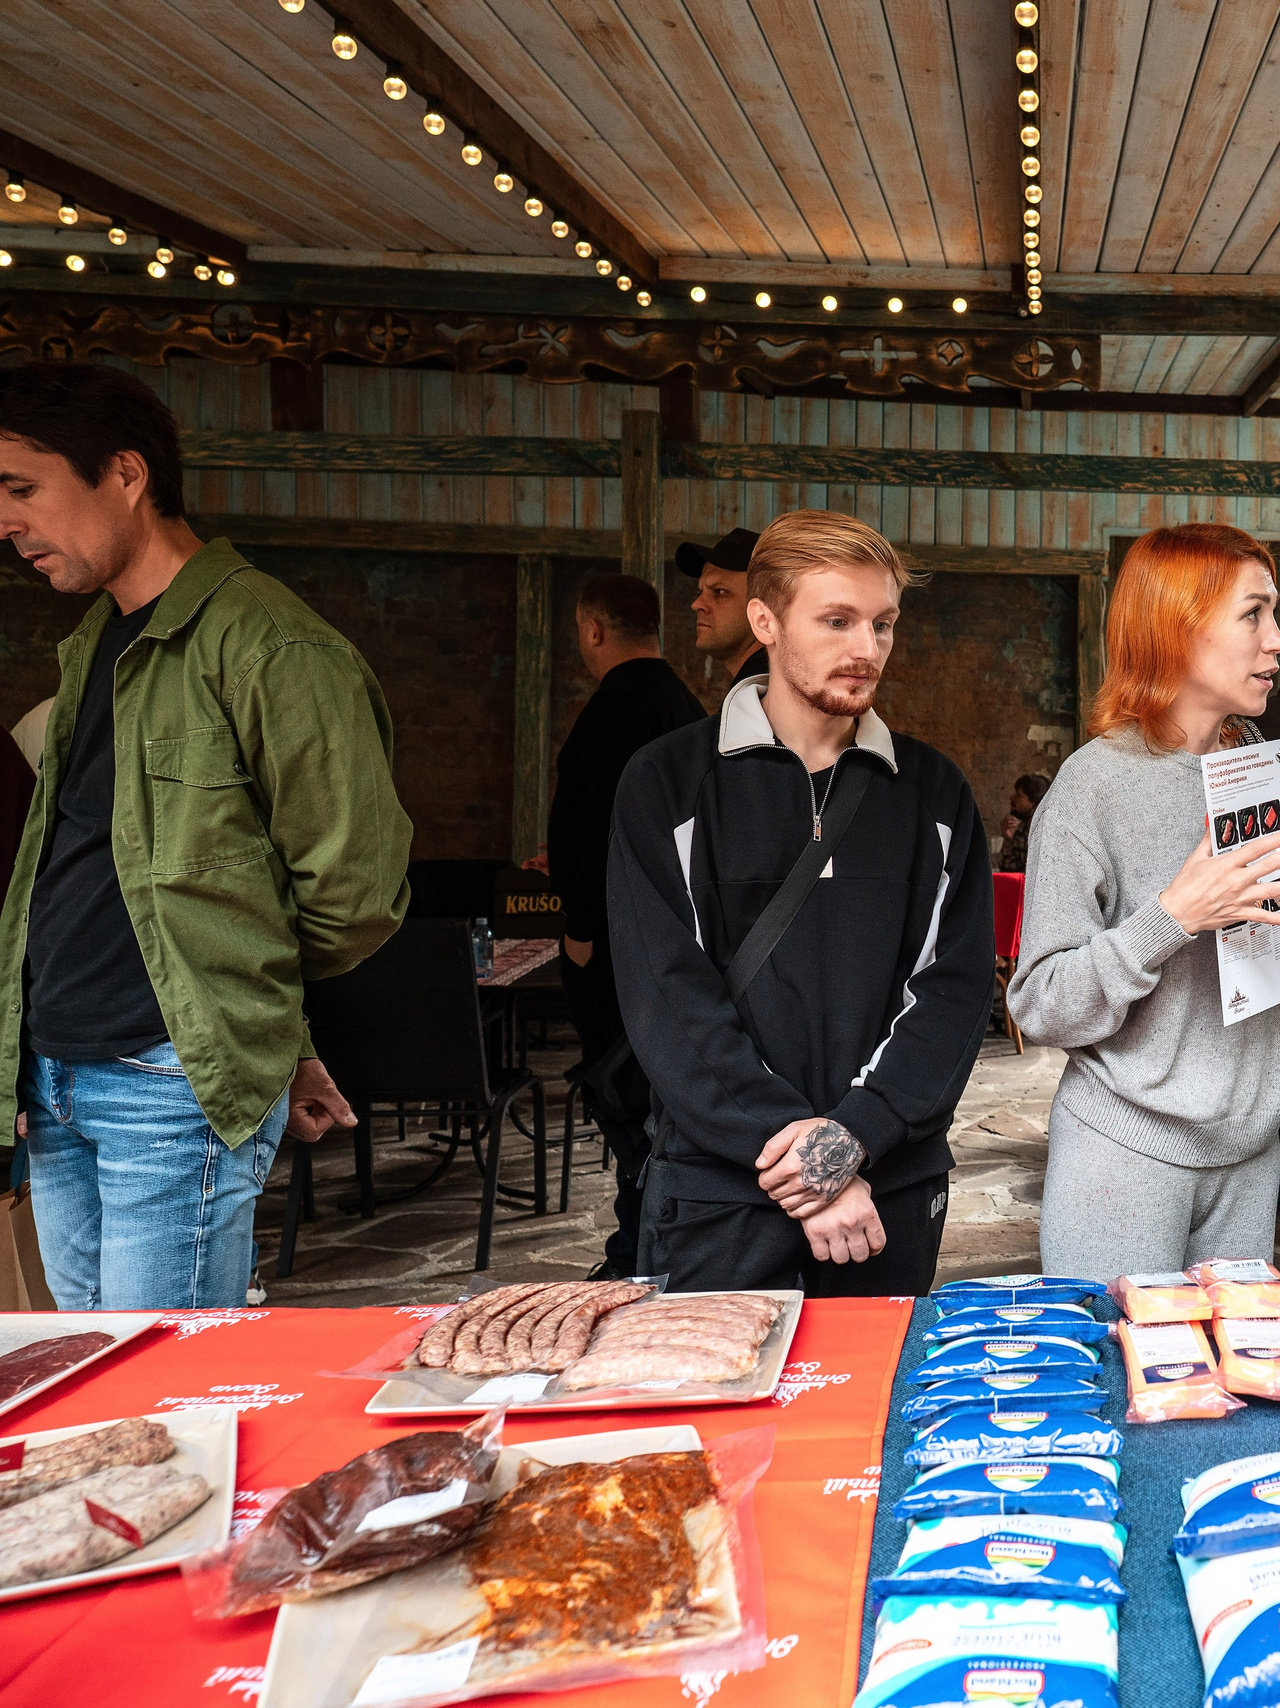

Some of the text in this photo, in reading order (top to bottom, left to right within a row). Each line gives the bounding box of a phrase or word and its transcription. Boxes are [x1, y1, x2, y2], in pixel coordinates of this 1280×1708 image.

[1206, 752, 1260, 770] Производитель мясных
[1208, 766, 1246, 780] полуфабрикатов
[1251, 760, 1274, 770] говядины
[1209, 775, 1248, 790] Южной Америки
[1213, 807, 1226, 816] Стейки
[505, 892, 563, 915] KRUŠO
[207, 1384, 280, 1395] Огонь
[153, 1393, 304, 1407] Открытый
[990, 1546, 1050, 1557] Hochland
[966, 1660, 1044, 1671] PROFESSIONAL
[965, 1677, 1037, 1688] Hochland
